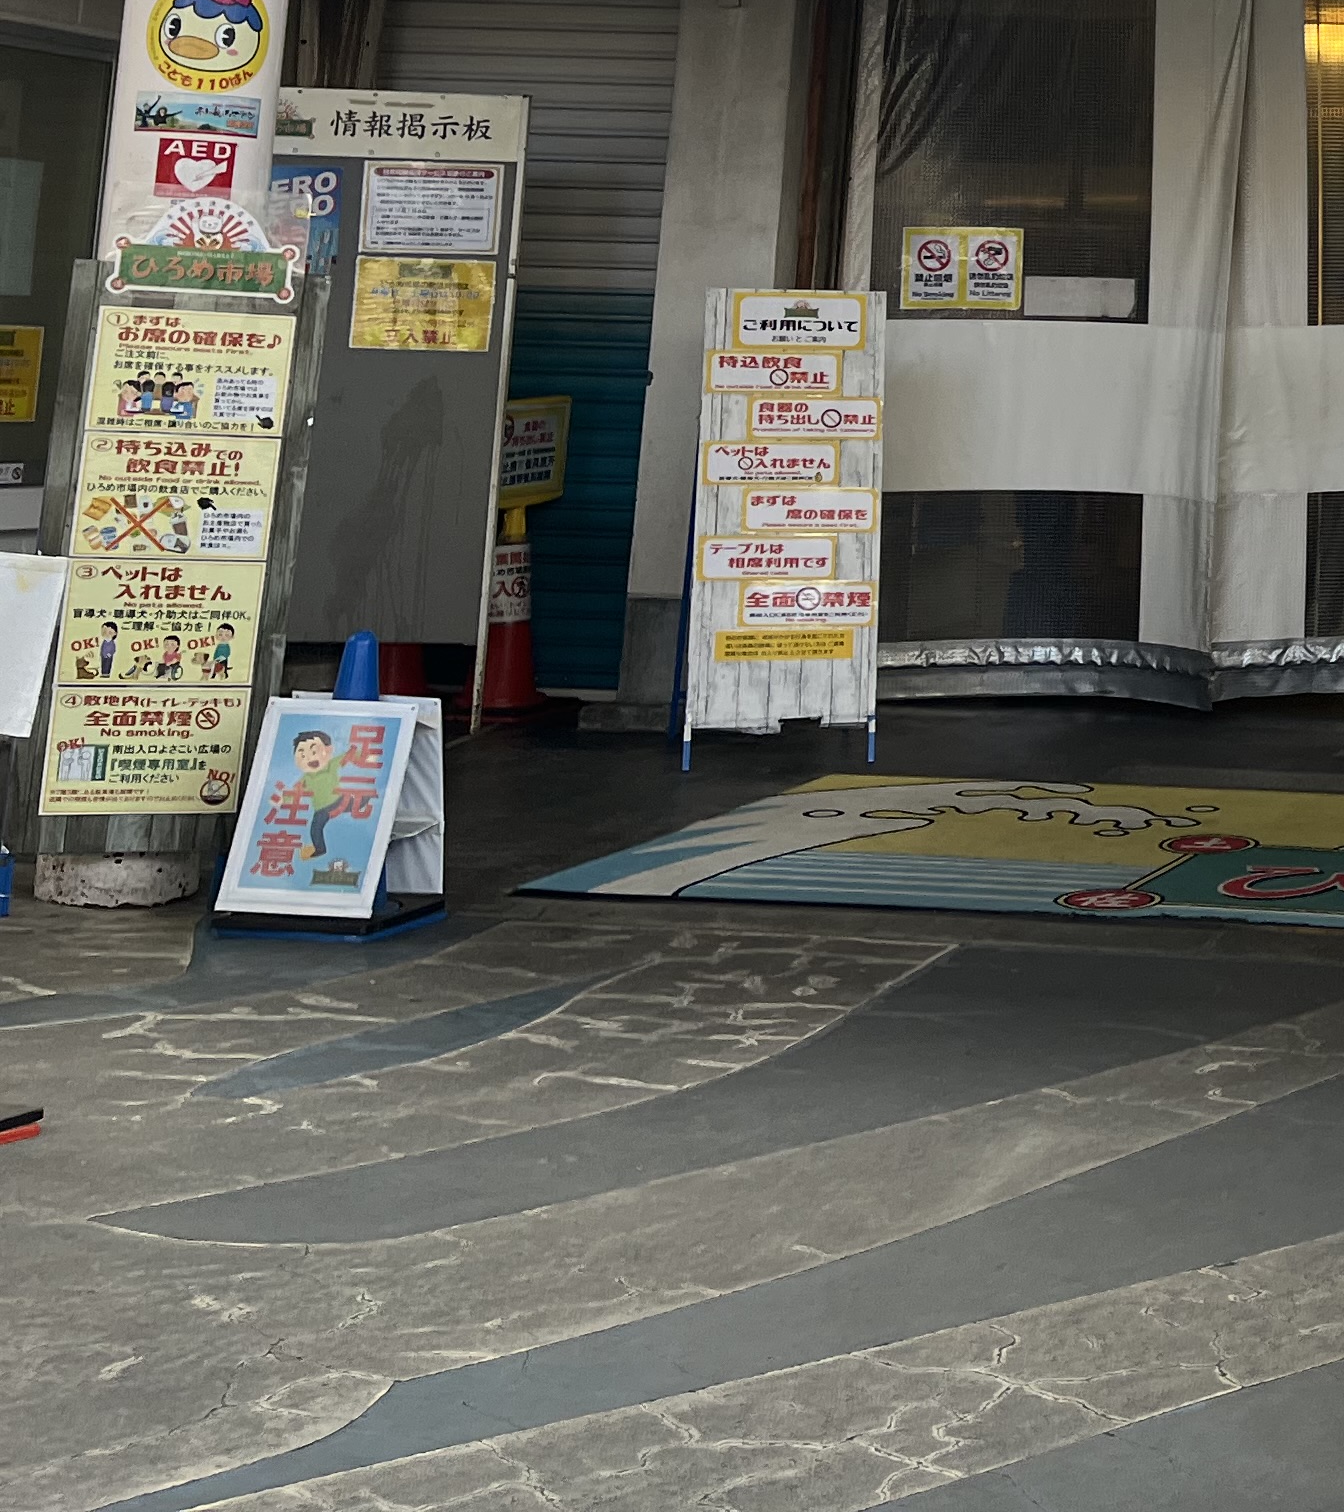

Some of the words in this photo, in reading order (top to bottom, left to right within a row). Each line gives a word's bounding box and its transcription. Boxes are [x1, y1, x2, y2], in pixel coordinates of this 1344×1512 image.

[330, 109, 493, 141] 情報掲示板
[164, 140, 231, 159] AED
[132, 255, 275, 286] ひろめ市場
[742, 319, 859, 332] ご利用について
[718, 355, 802, 369] 持込飲食
[789, 371, 830, 384] 禁止
[758, 402, 809, 413] 食器の
[758, 414, 820, 425] 持ち出し
[843, 414, 876, 425] 禁止
[715, 446, 769, 457] ペットは
[753, 458, 831, 469] 入れません
[751, 495, 797, 506] まずは
[710, 543, 784, 555] テーブルは
[727, 557, 829, 569] 相席利用です
[102, 565, 183, 582] ペットは
[114, 584, 232, 601] 入れません
[745, 591, 796, 608] 全面
[821, 591, 871, 608] 禁煙
[71, 637, 99, 652] OK!
[131, 637, 159, 652] OK!
[187, 635, 216, 650] OK!
[84, 710, 192, 727] 全面禁煙
[101, 728, 121, 737] No
[126, 728, 194, 738] smoking.
[329, 724, 386, 821] 足元
[250, 781, 314, 877] 注意
